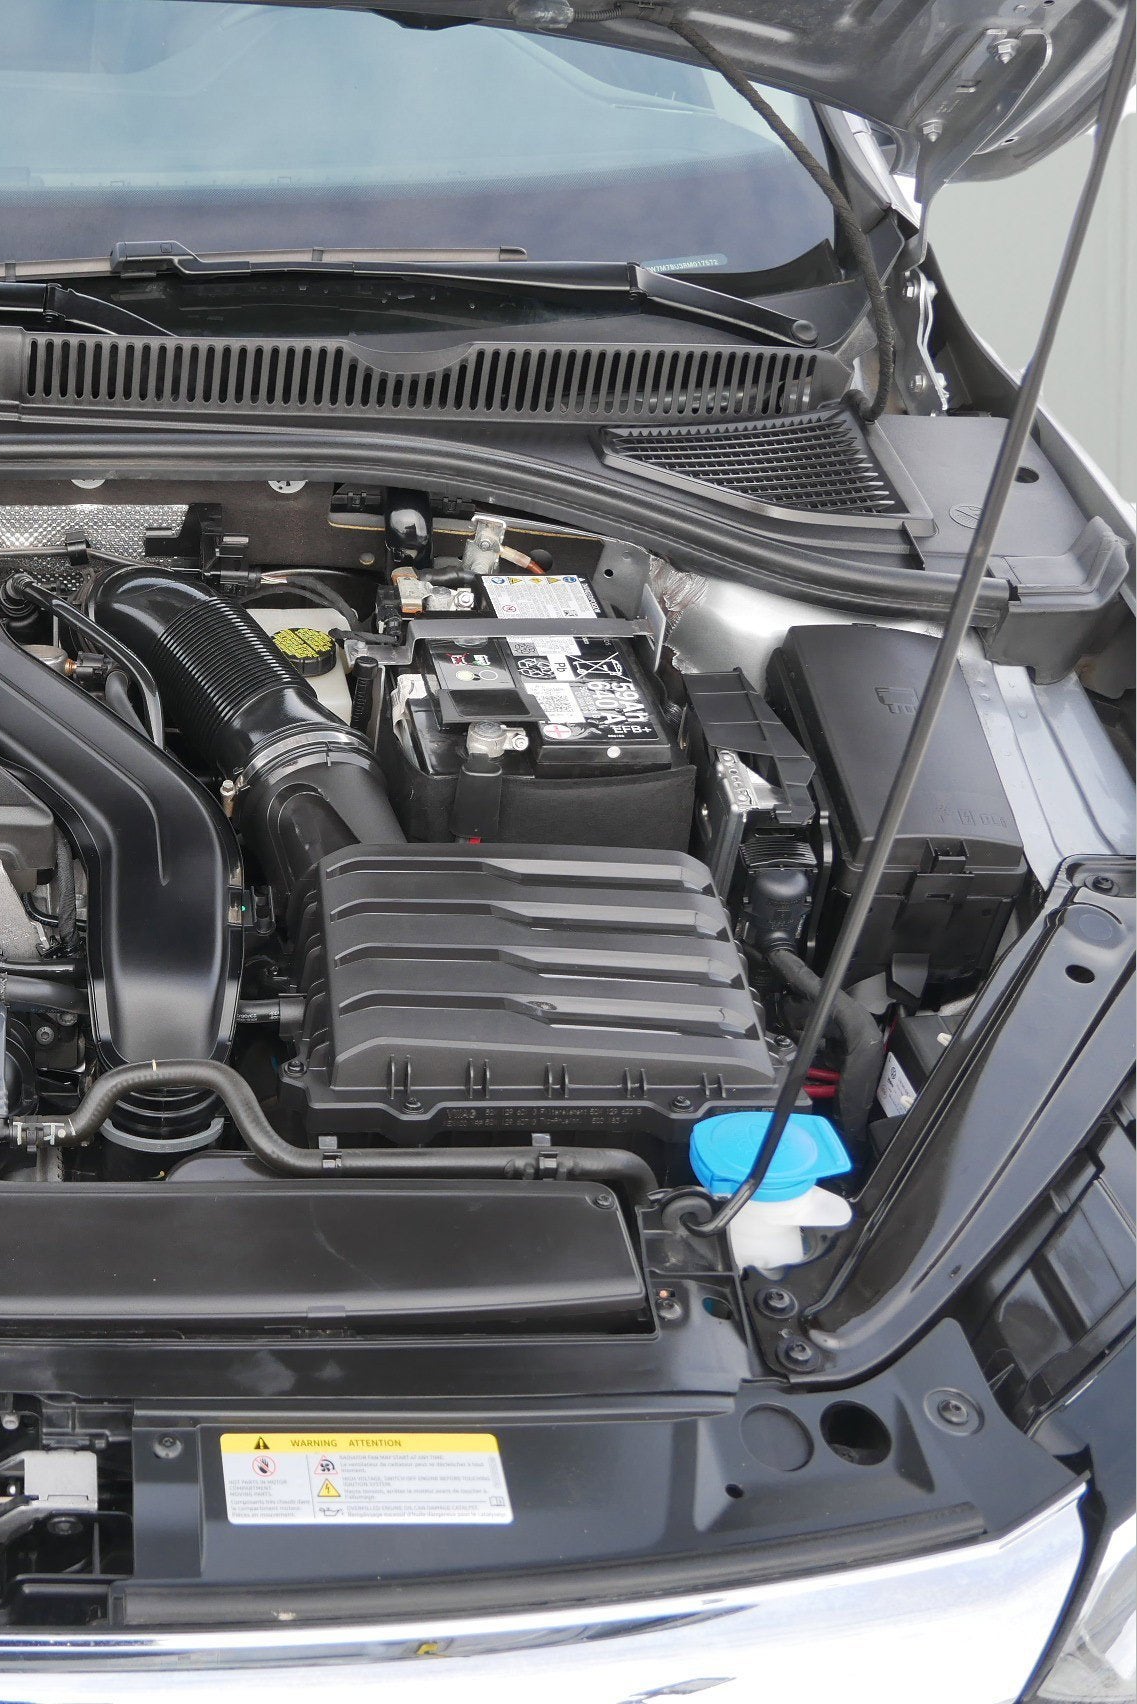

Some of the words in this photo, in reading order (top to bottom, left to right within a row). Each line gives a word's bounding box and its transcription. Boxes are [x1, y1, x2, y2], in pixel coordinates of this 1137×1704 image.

[554, 662, 566, 673] Pb
[611, 725, 652, 733] EFB+
[290, 1439, 337, 1447] WARNING
[349, 1439, 402, 1447] ATTENTION
